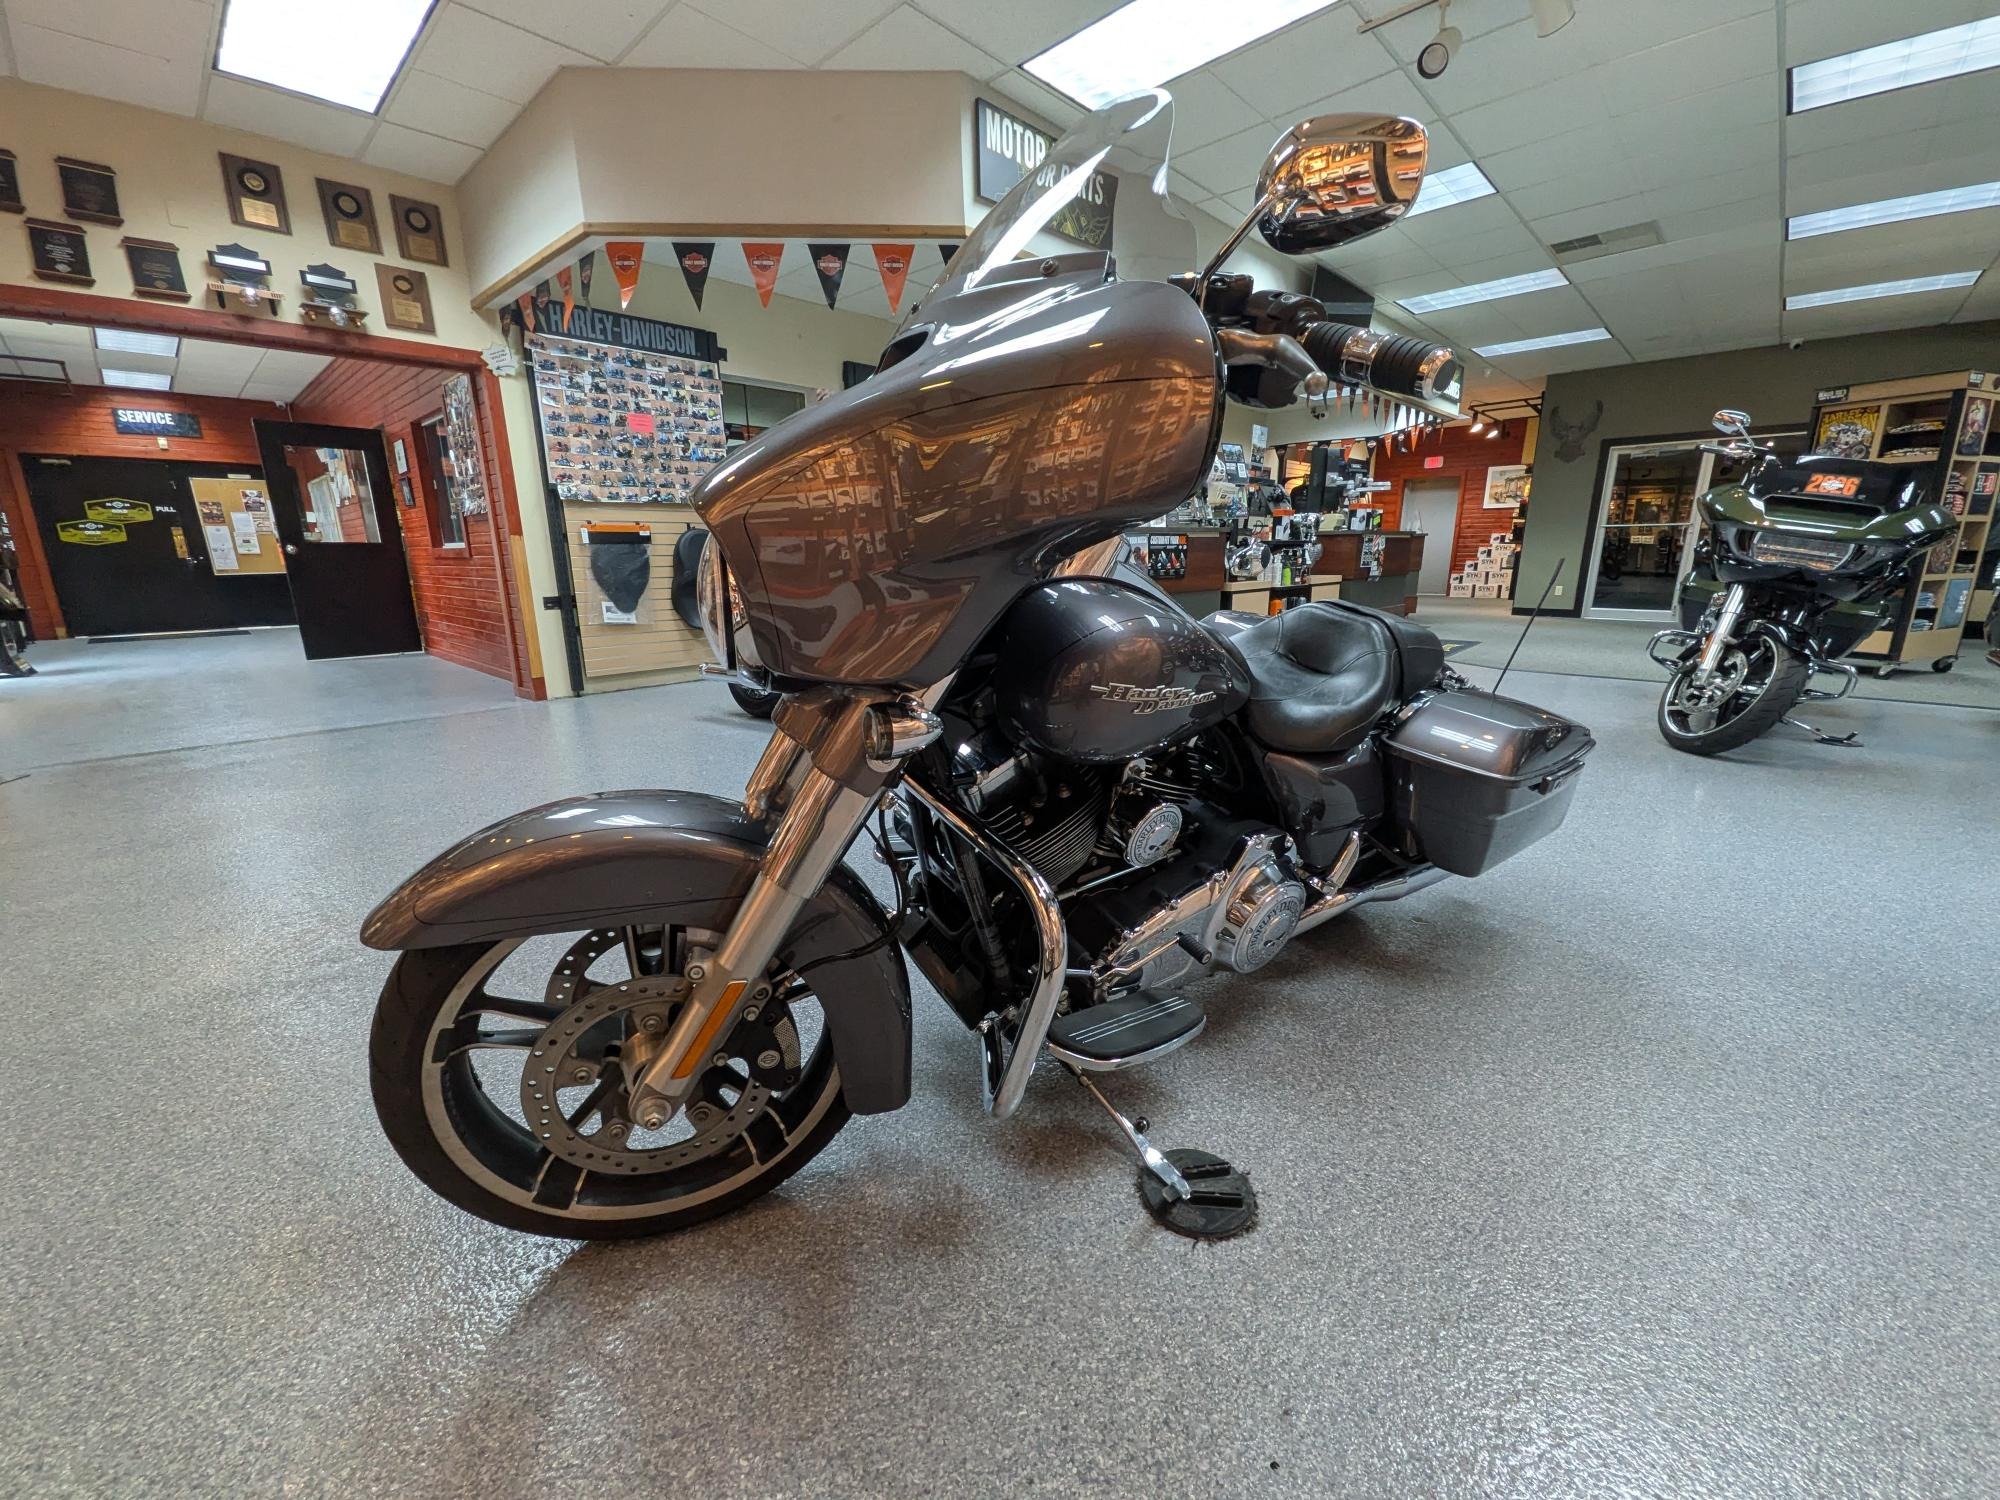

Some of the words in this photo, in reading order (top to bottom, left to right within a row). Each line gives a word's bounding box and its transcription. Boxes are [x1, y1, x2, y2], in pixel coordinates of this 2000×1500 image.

[985, 107, 1046, 169] MOTOR
[1060, 165, 1104, 205] PTS
[117, 409, 176, 425] SERVICE
